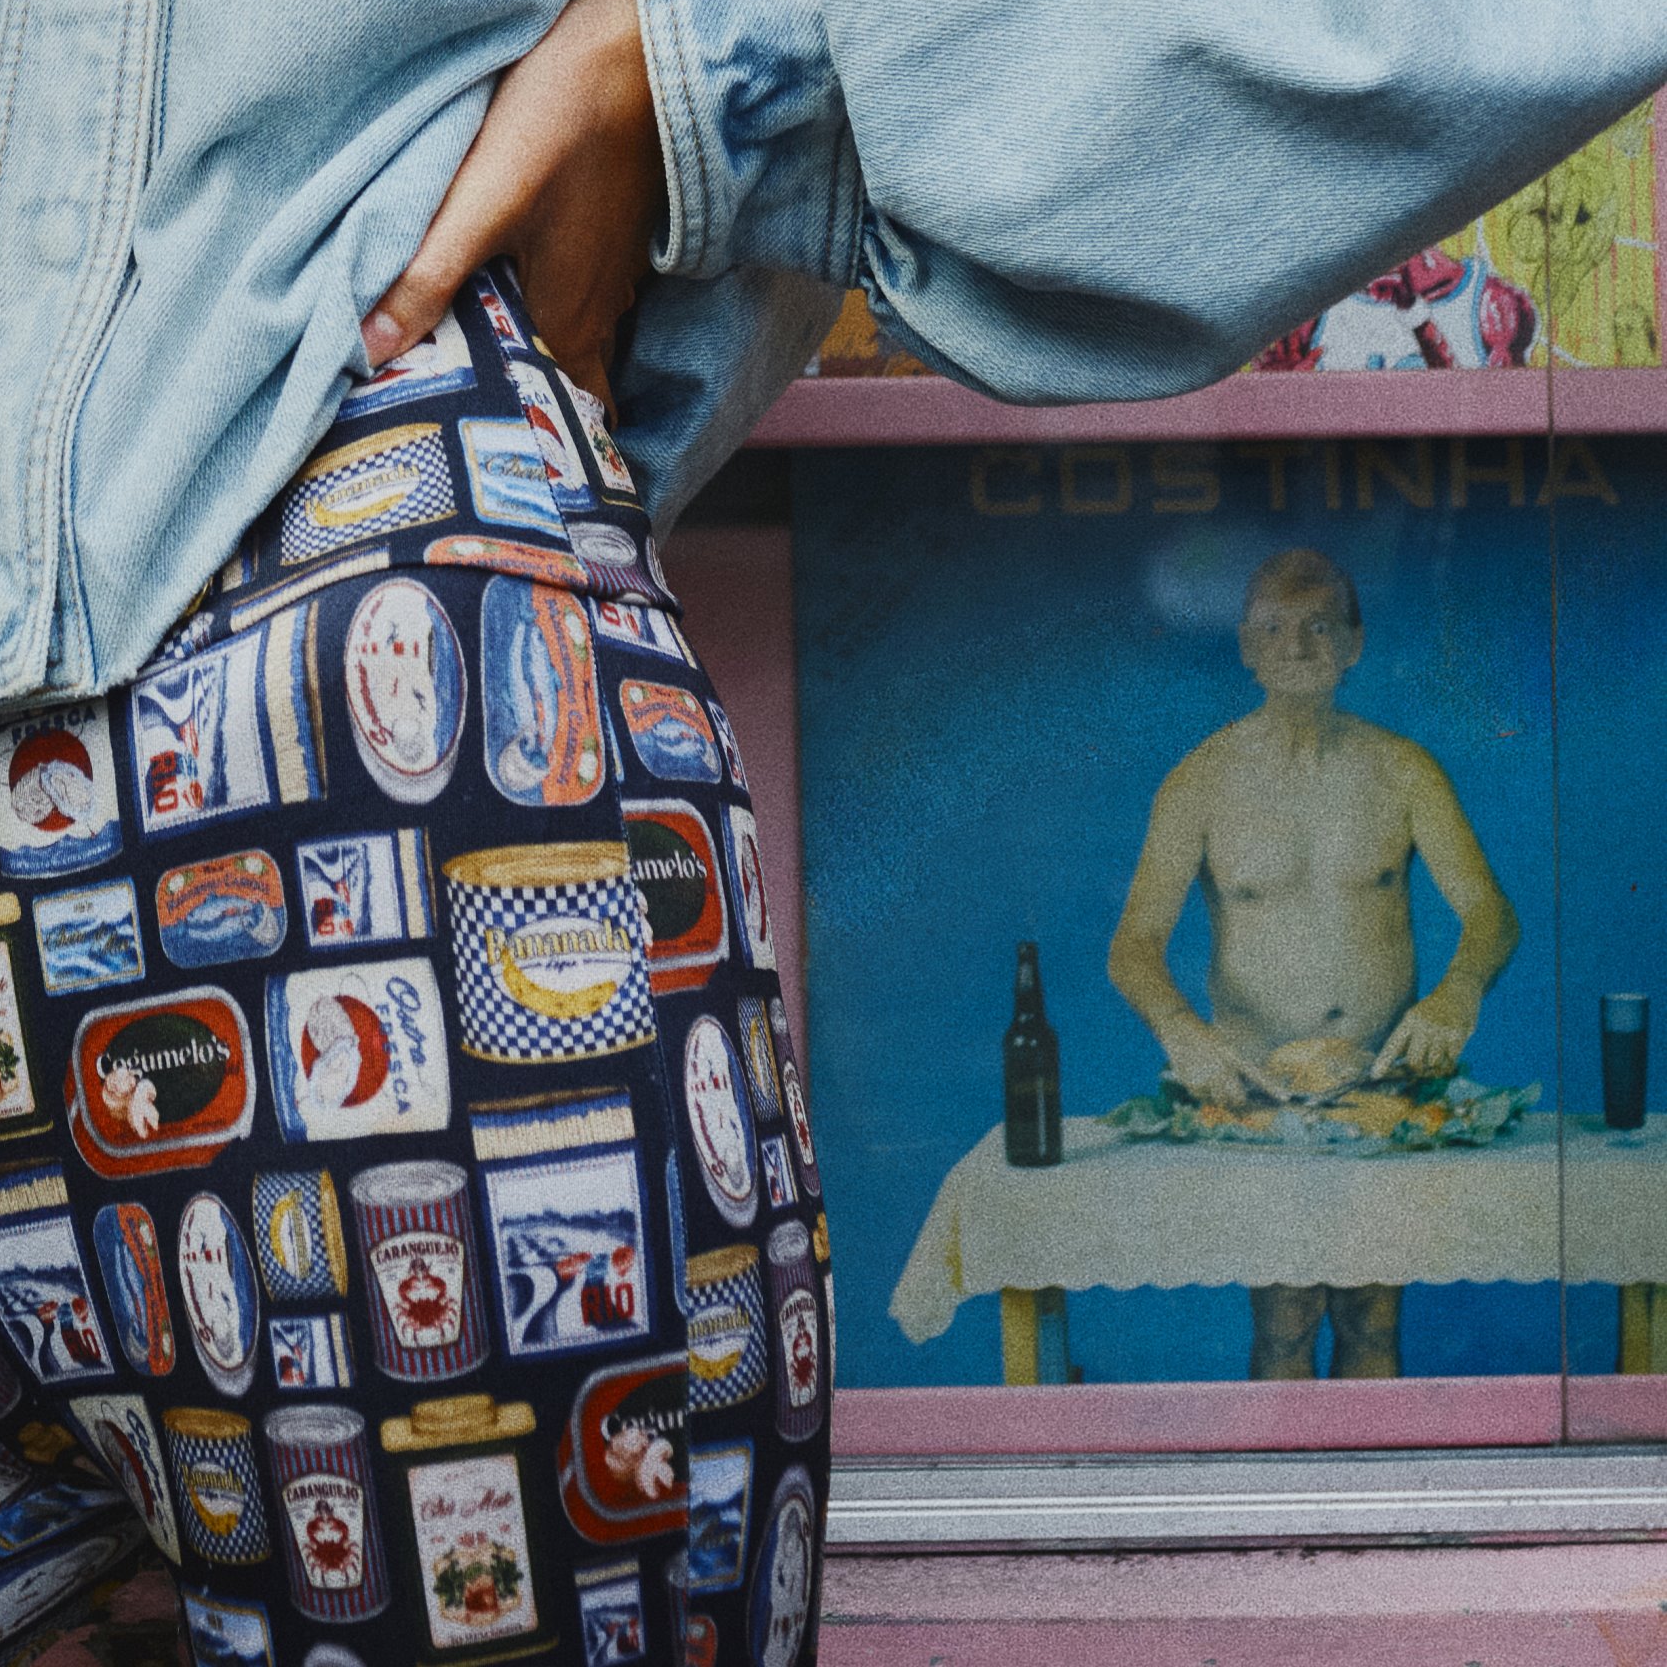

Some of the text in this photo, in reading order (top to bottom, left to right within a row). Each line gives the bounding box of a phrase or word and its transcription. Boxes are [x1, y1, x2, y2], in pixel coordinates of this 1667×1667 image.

[968, 437, 1618, 516] COSTINHA
[149, 750, 180, 814] RIO
[485, 917, 633, 966] Bananada
[96, 1035, 231, 1082] Cogumelo's
[375, 1241, 461, 1265] CARANGUEJO
[581, 1282, 635, 1326] RIO
[286, 1482, 360, 1505] CARANGUEJO
